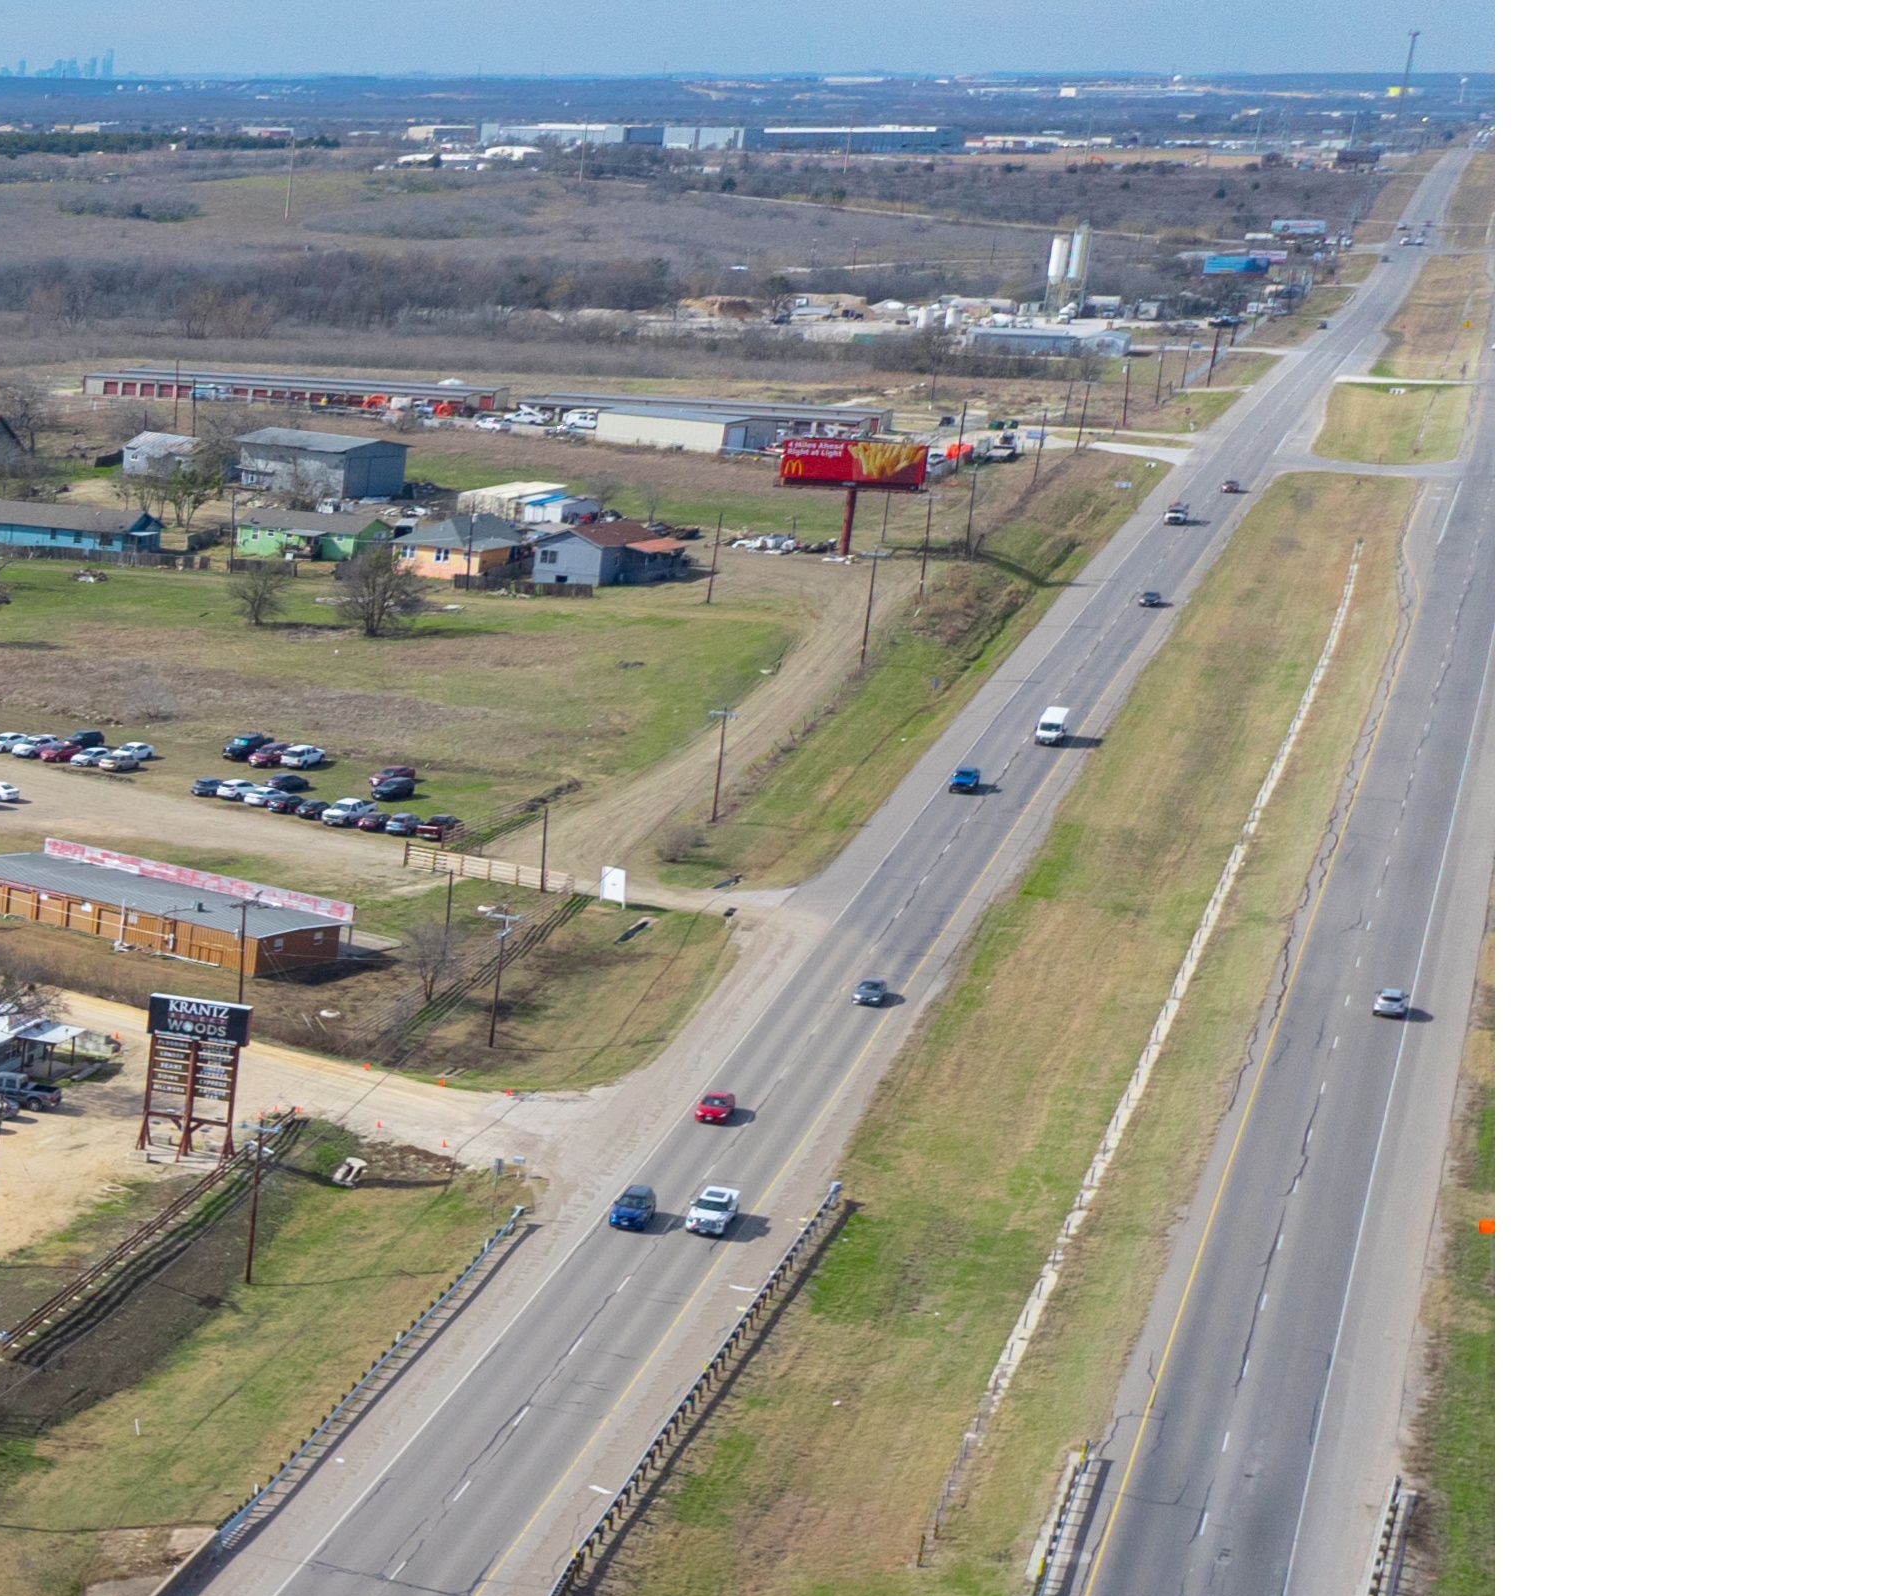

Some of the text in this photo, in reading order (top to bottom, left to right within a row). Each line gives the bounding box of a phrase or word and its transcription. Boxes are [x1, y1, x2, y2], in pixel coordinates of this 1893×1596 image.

[818, 442, 844, 450] Ahead
[787, 448, 810, 457] Right
[820, 449, 843, 458] Light
[168, 1000, 229, 1019] KRANTZ
[169, 1012, 226, 1024] SELECT
[167, 1018, 227, 1037] WOODS
